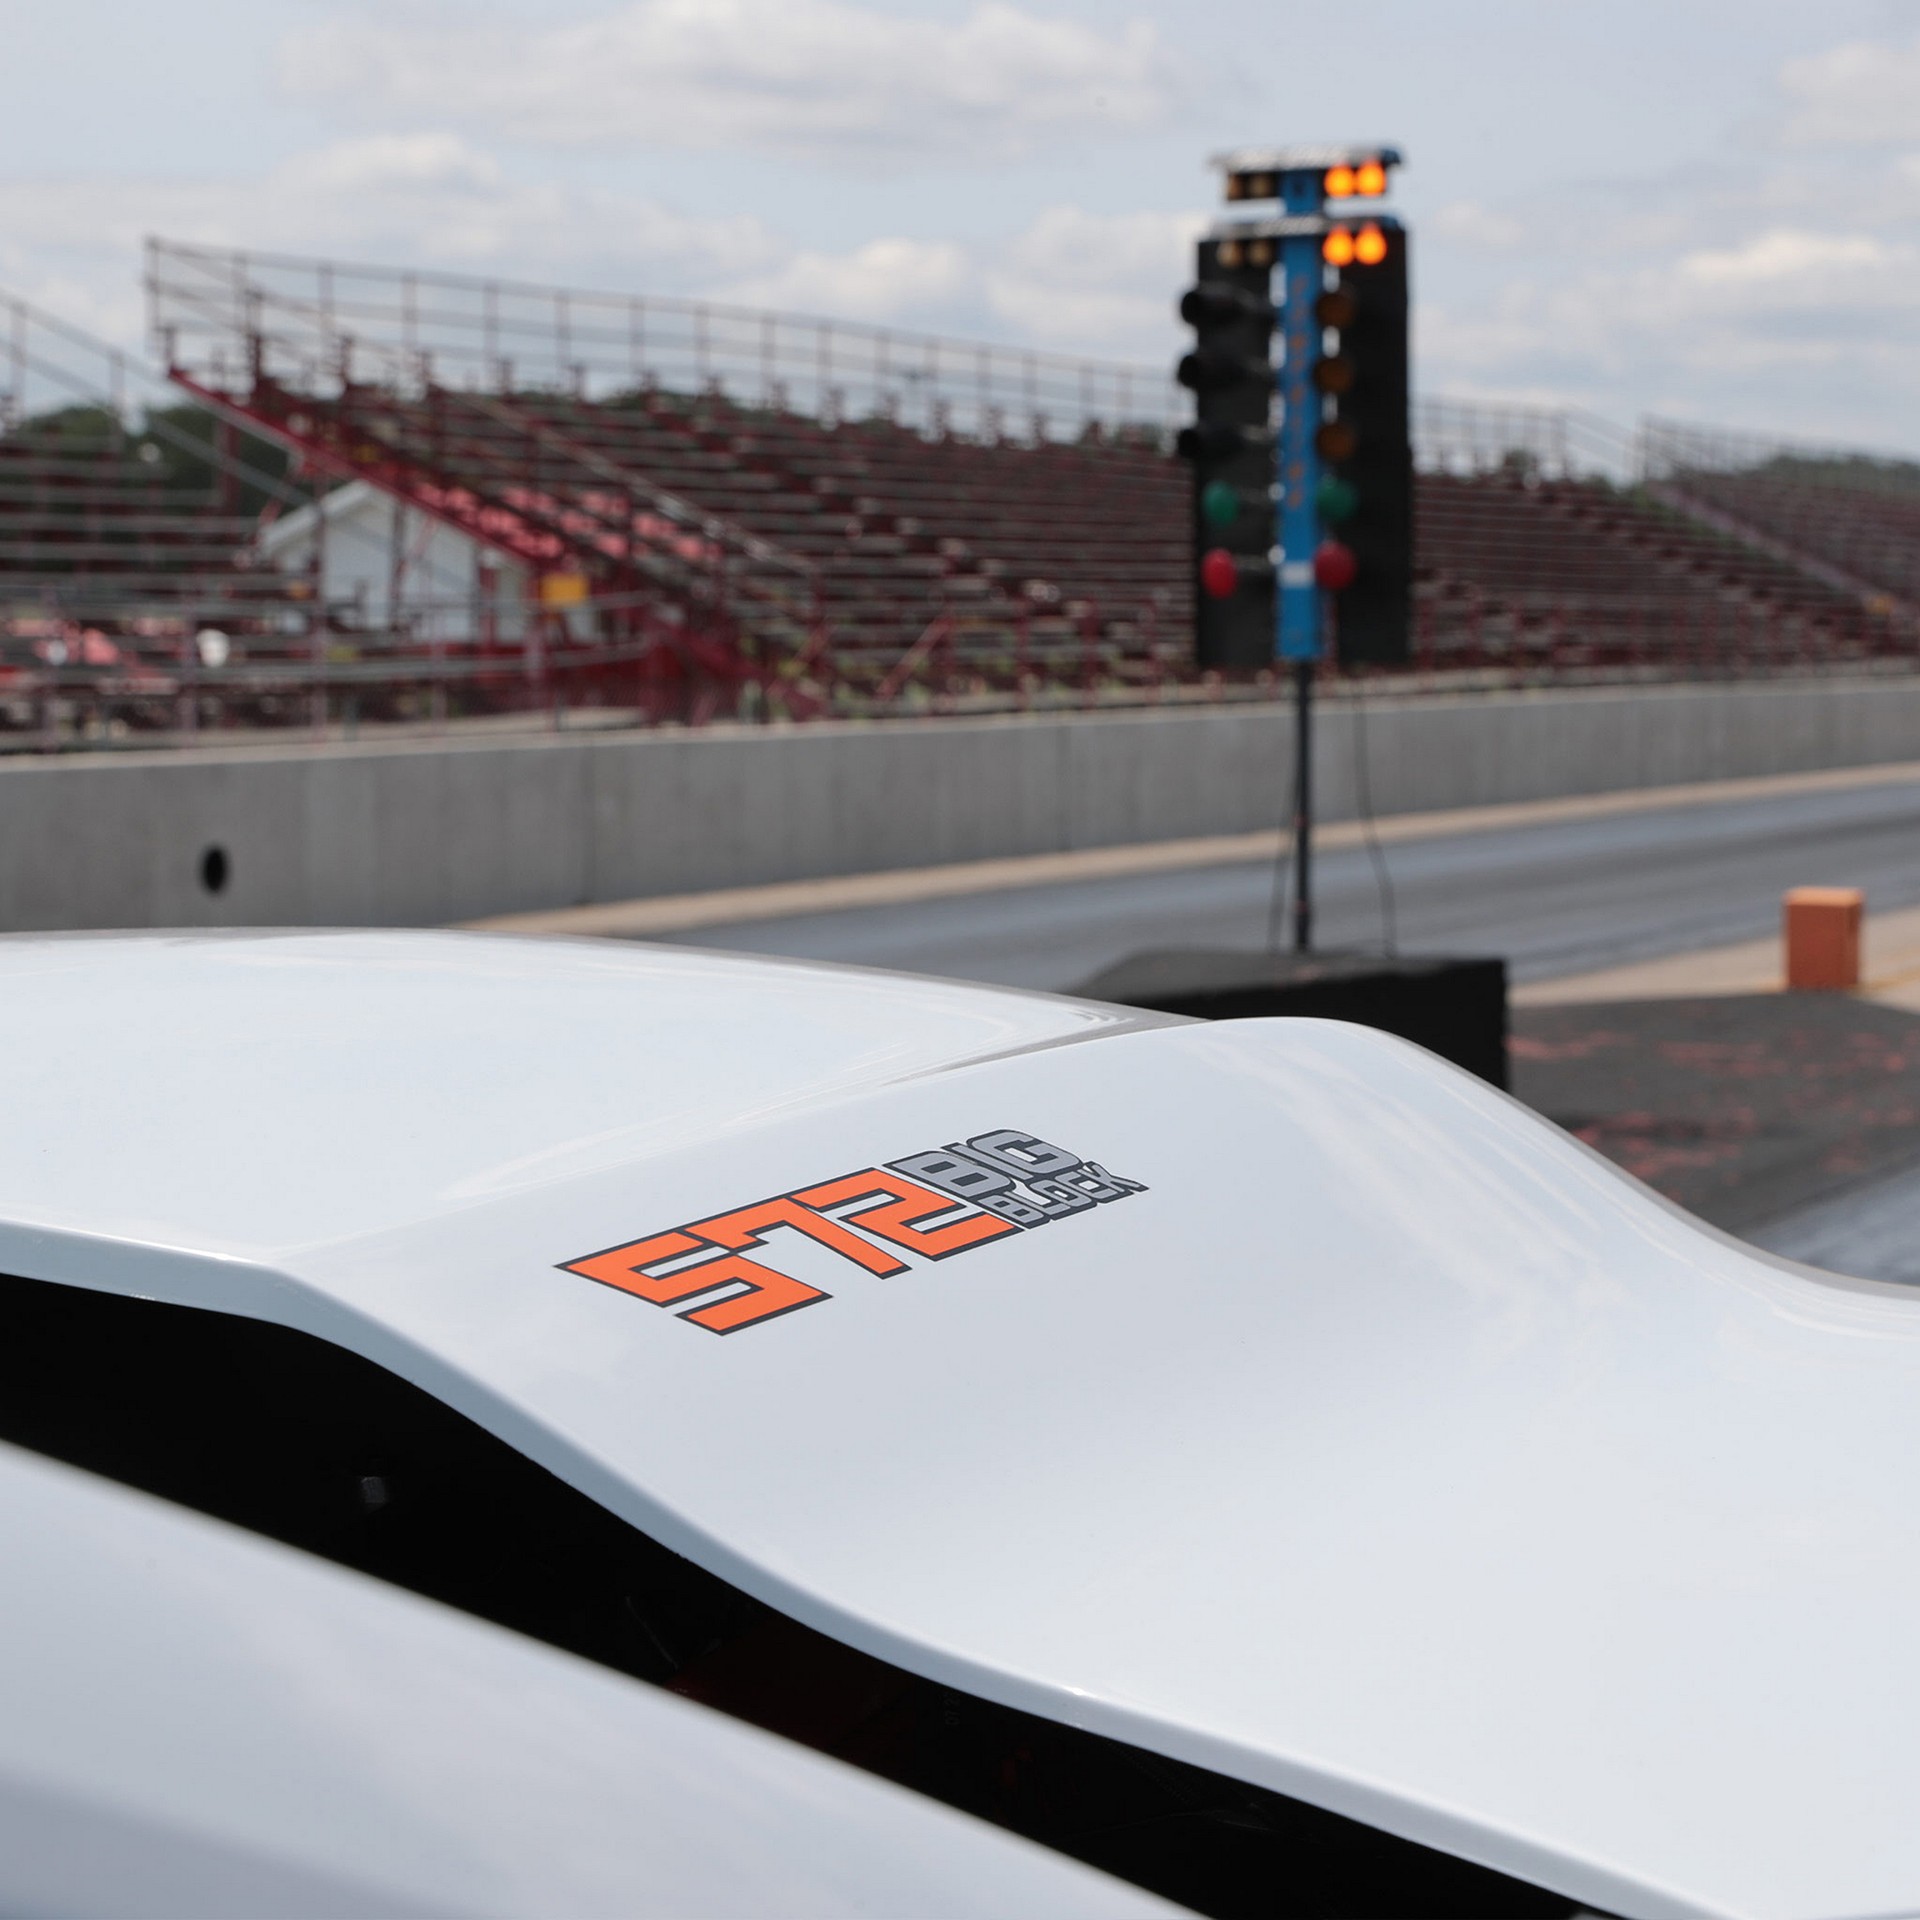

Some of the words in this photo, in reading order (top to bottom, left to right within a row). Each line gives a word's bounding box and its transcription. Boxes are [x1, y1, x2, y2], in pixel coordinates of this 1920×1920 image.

[882, 1129, 1084, 1198] BIG
[972, 1161, 1150, 1229] BLOCK
[554, 1167, 1026, 1336] 572
